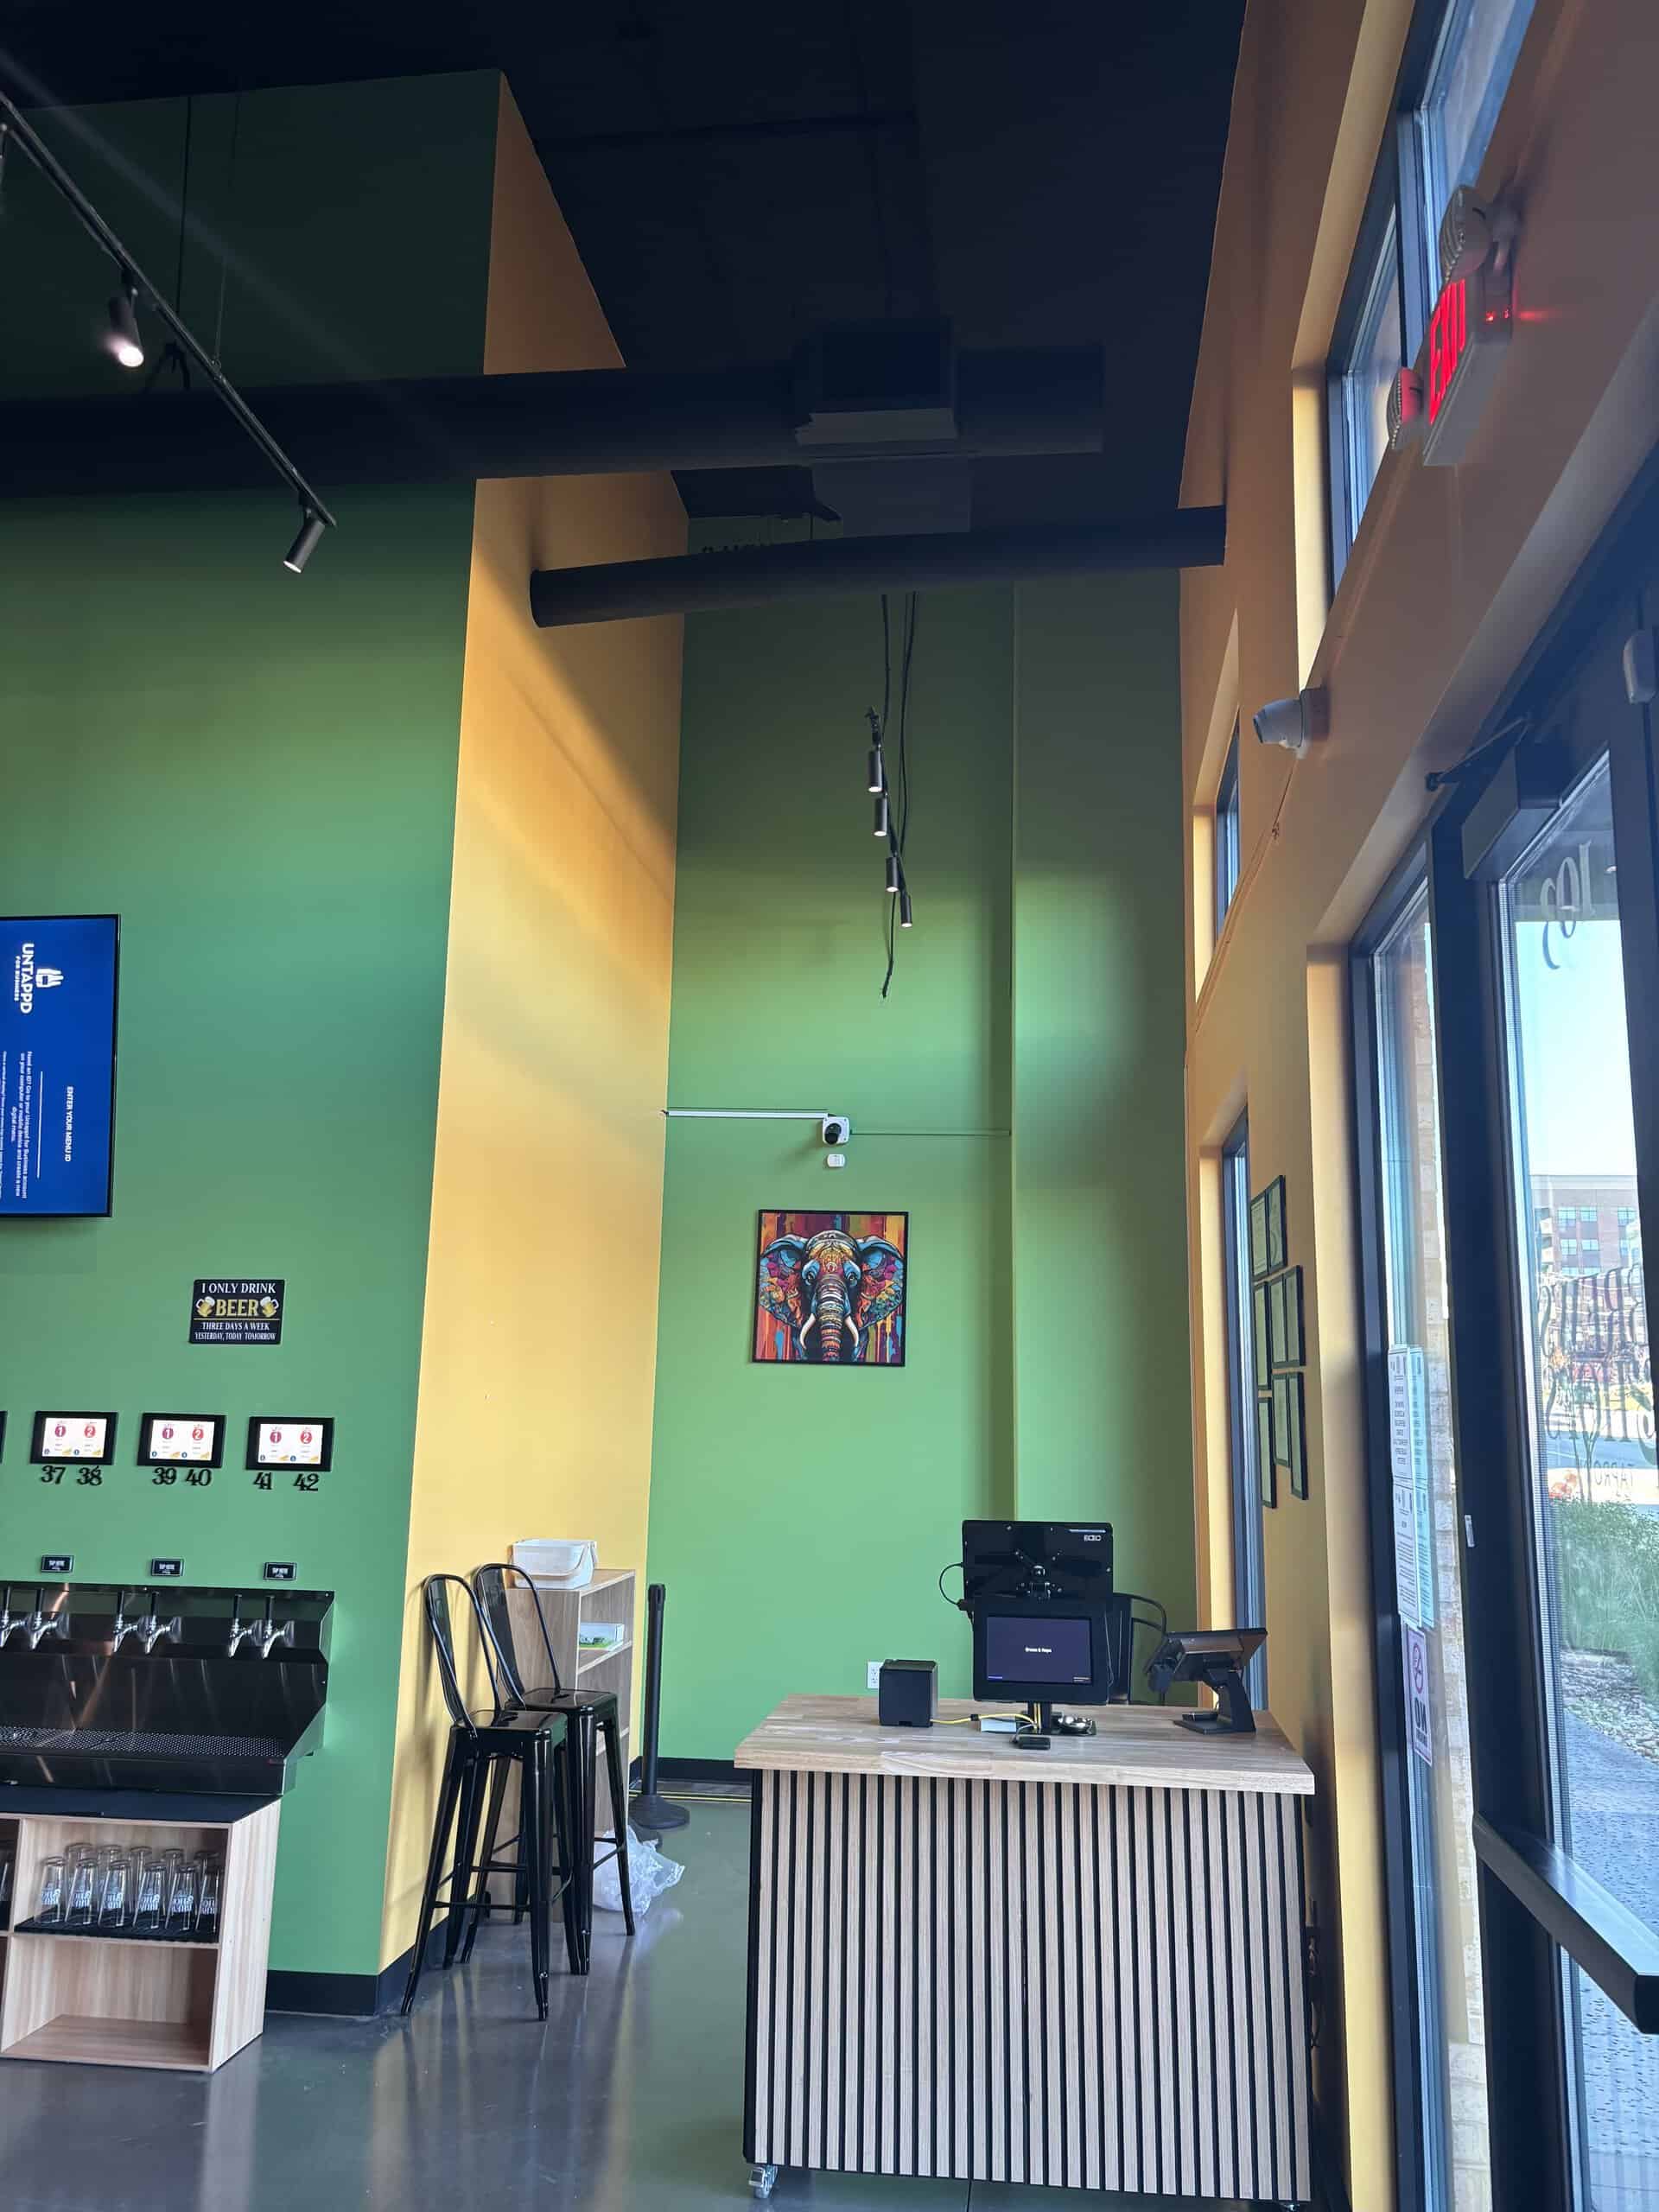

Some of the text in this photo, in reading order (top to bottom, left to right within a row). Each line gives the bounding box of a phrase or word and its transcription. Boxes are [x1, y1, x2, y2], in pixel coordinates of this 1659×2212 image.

[20, 943, 35, 1014] UNTAPPD
[201, 1282, 276, 1294] I ONLY DRINK
[215, 1299, 259, 1317] BEER
[201, 1321, 270, 1331] THREE DAYS A WEEK
[244, 1332, 276, 1340] TOMORROW
[41, 1465, 103, 1486] 37 38
[152, 1466, 213, 1486] 39 40
[253, 1471, 320, 1491] 41 42
